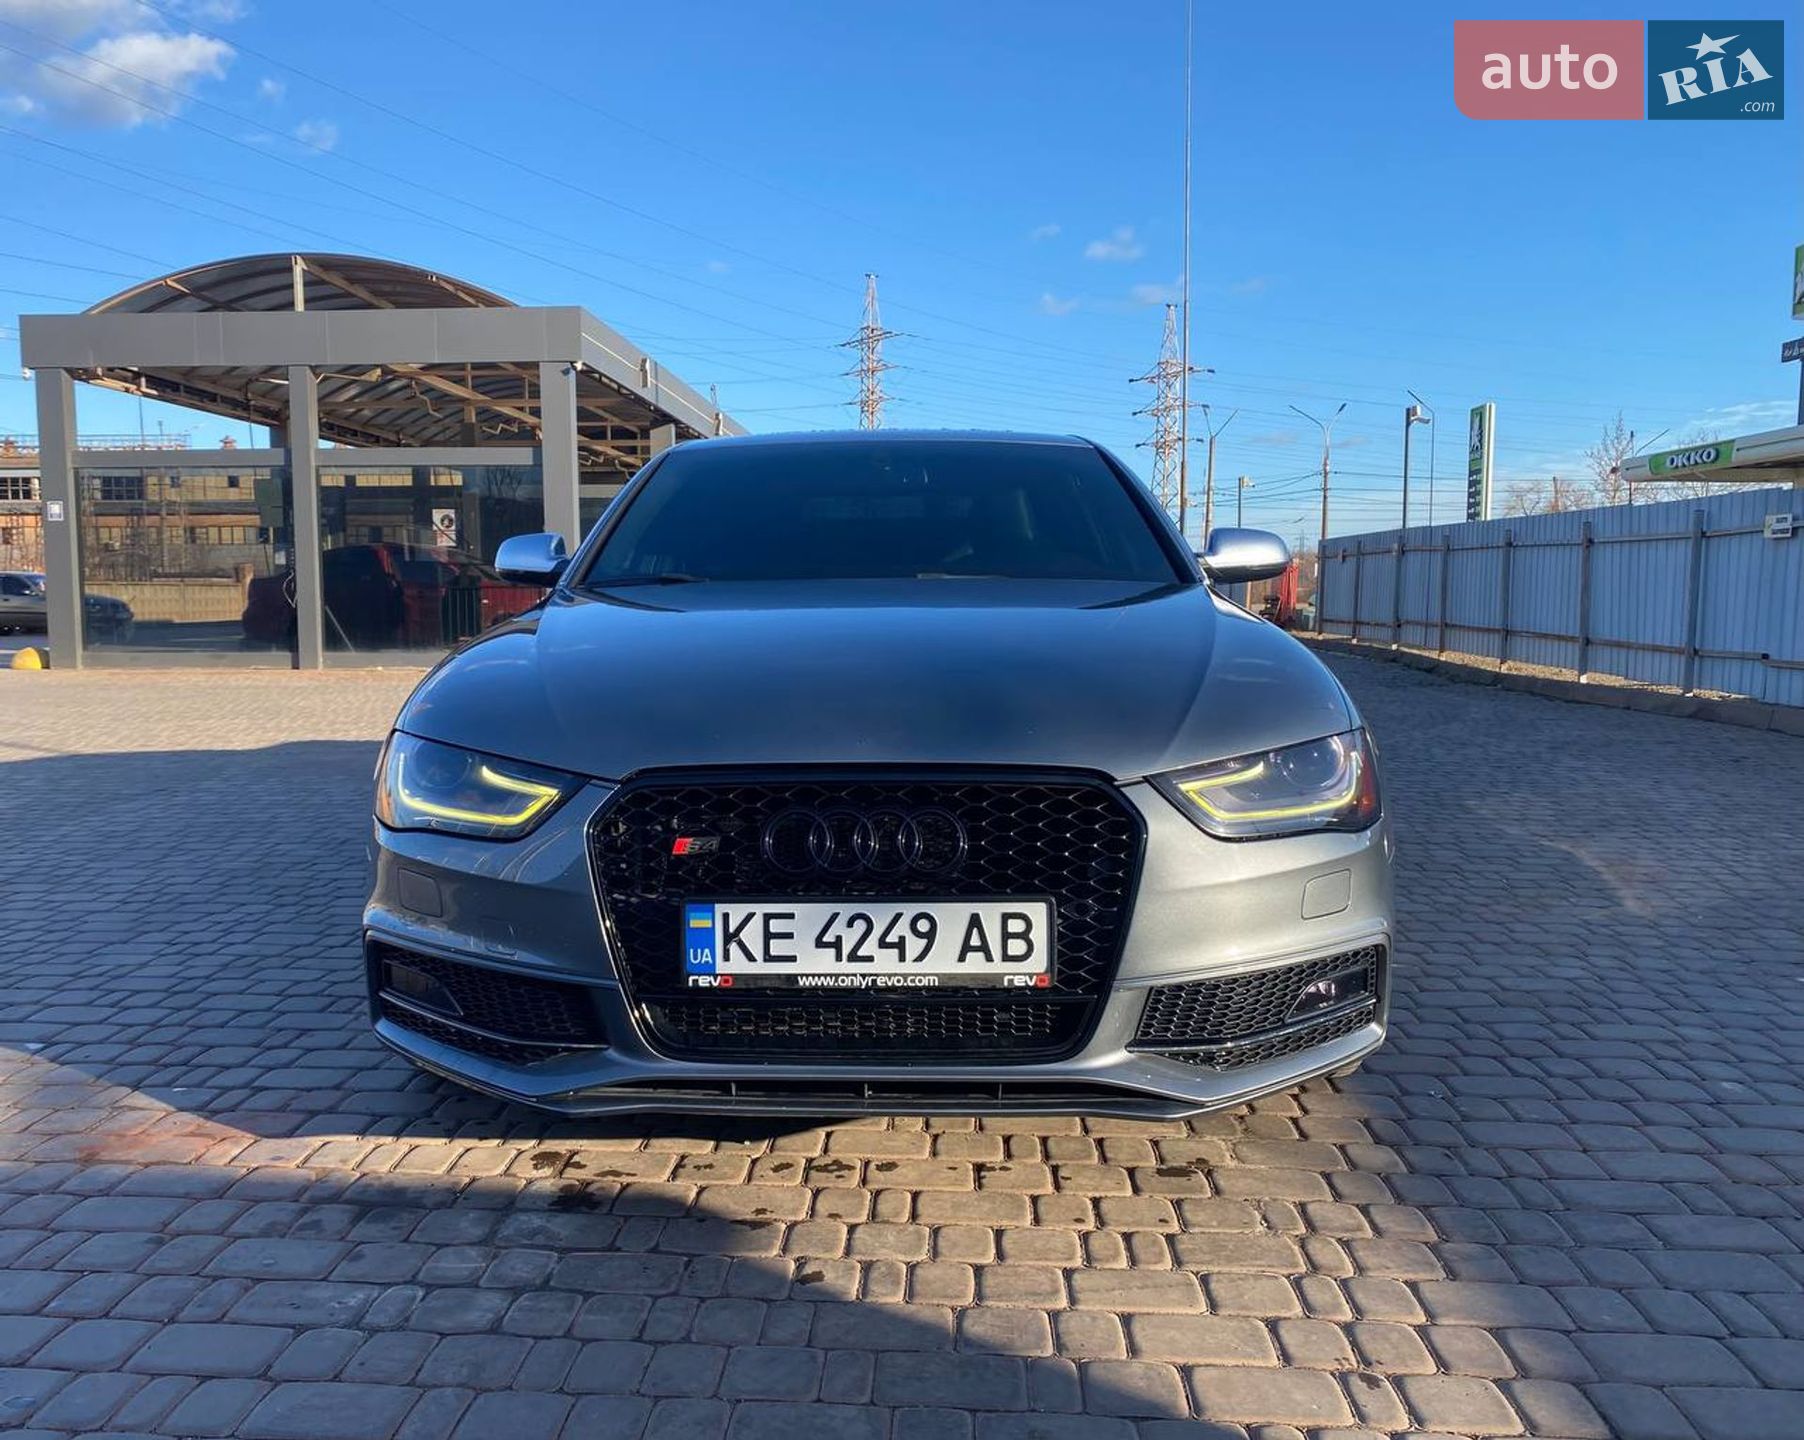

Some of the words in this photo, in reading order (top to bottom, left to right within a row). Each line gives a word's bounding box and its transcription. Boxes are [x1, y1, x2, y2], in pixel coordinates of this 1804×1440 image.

[1665, 448, 1716, 469] OKKO
[721, 911, 798, 963] KE
[814, 911, 938, 963] 4249
[957, 911, 1035, 963] AB
[689, 948, 713, 965] UA
[688, 975, 733, 987] revo
[798, 974, 938, 988] www.onlyrevo.com
[1003, 975, 1049, 987] revo
